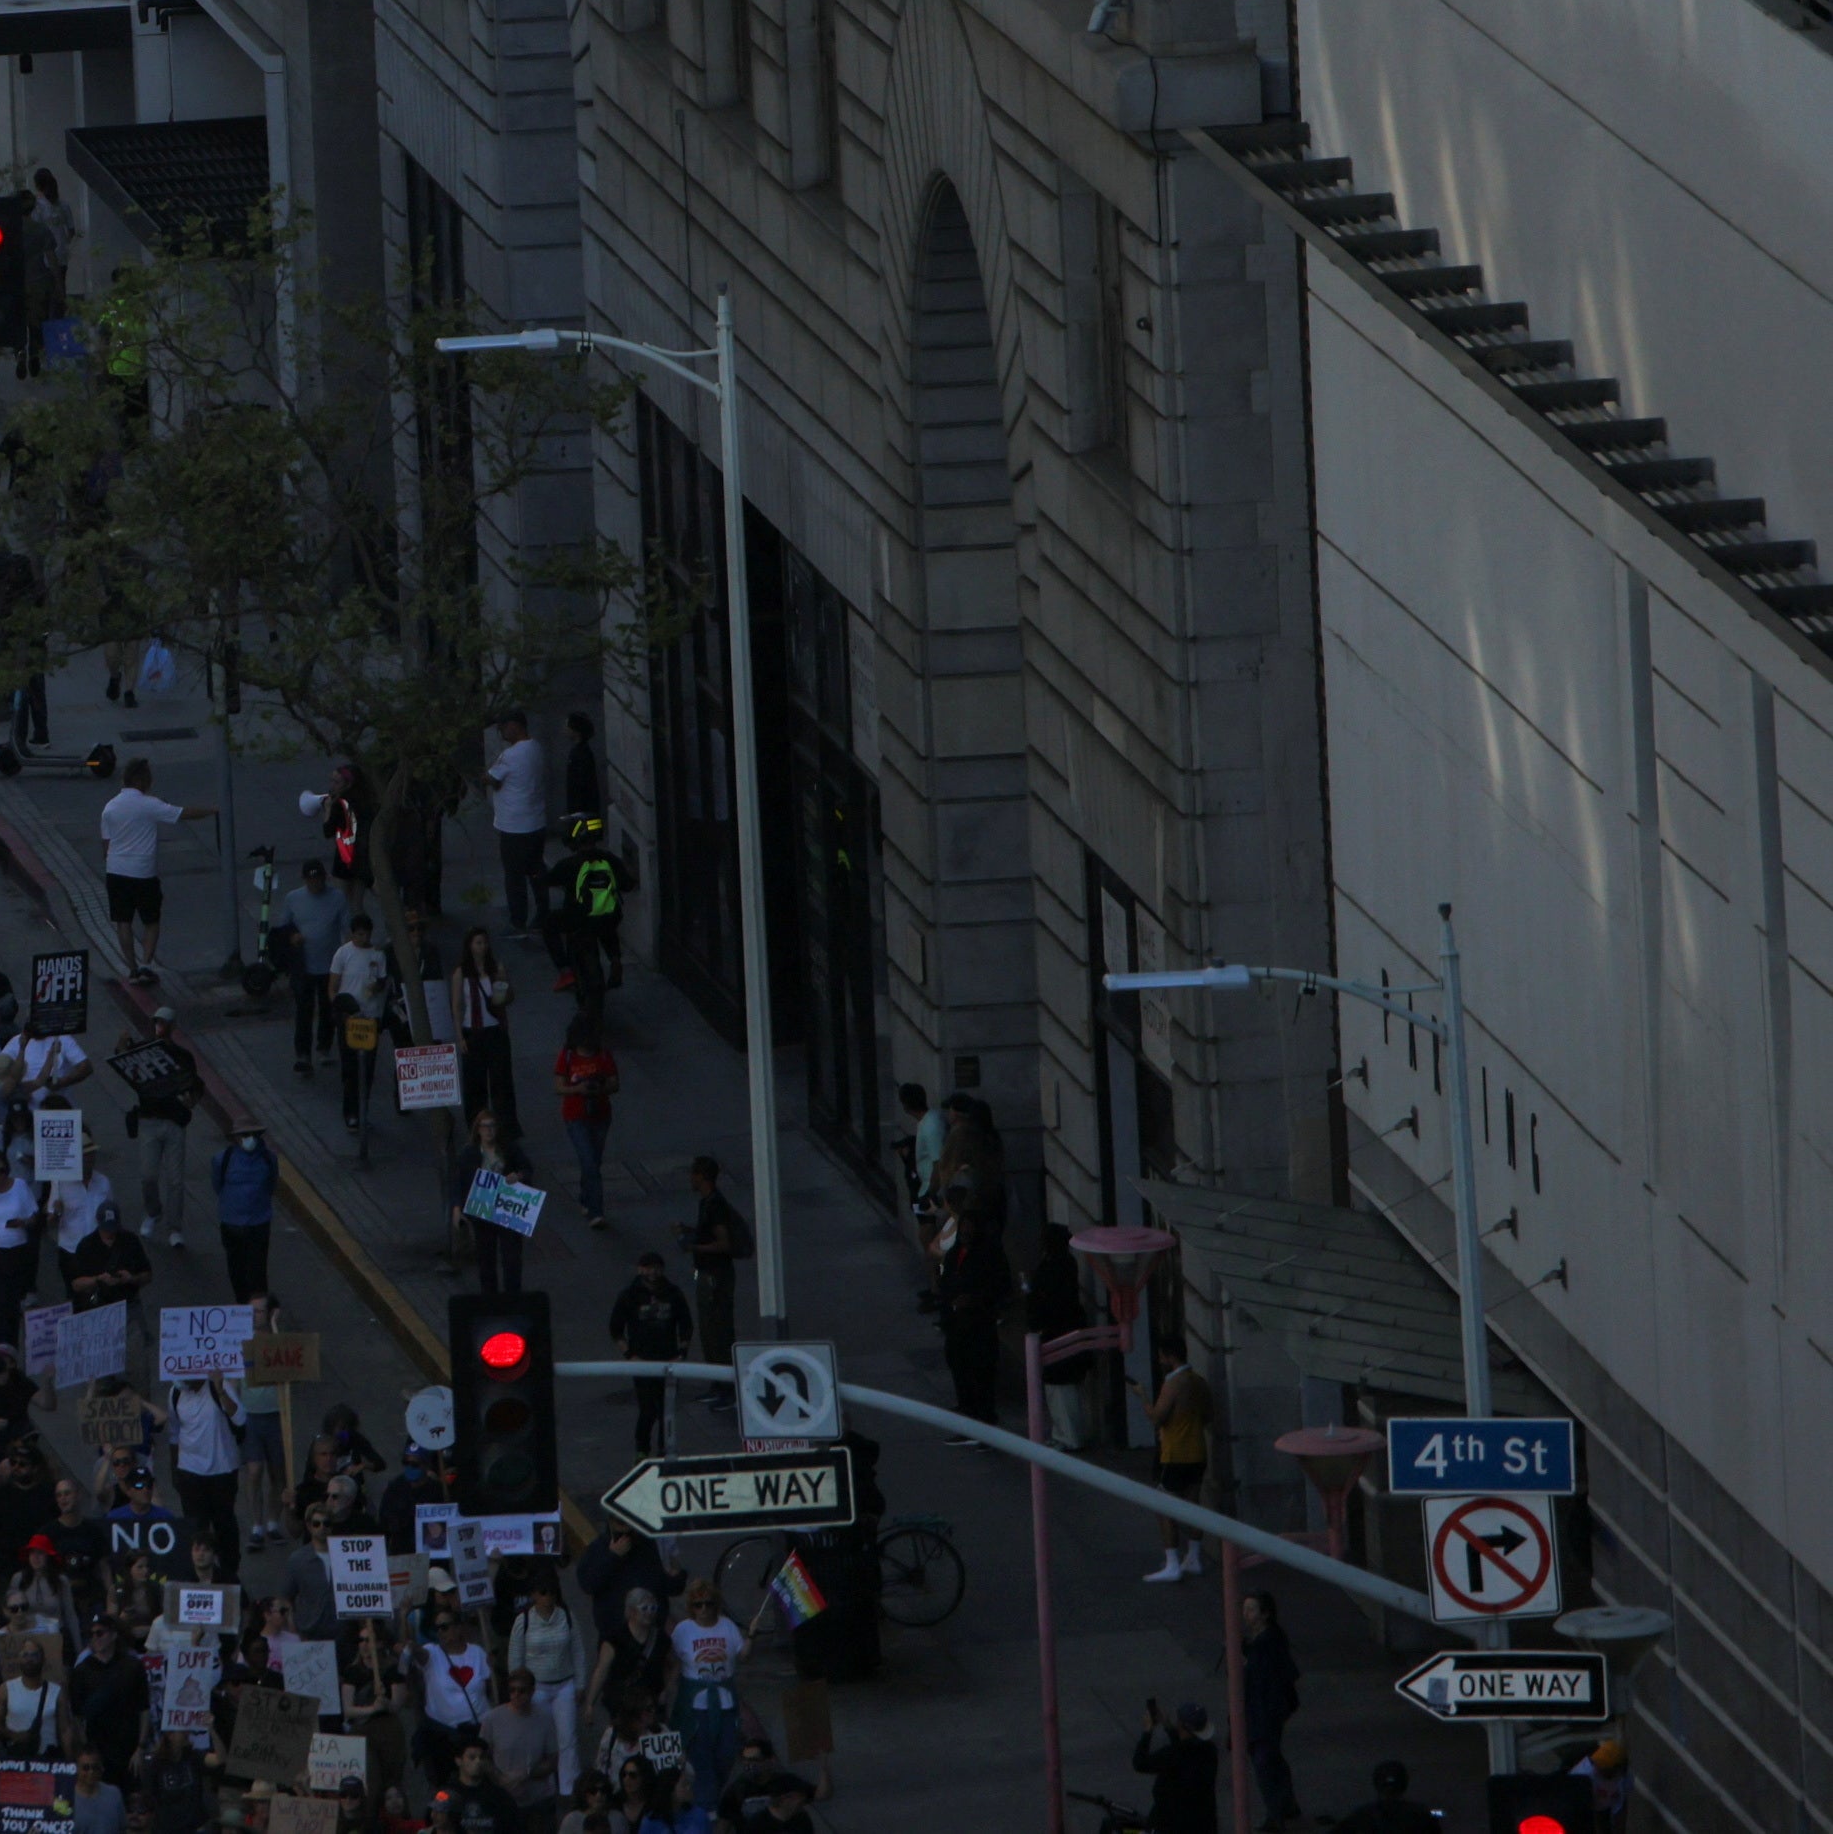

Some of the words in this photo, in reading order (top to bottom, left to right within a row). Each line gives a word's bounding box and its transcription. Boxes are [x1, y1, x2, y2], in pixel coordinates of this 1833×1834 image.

[36, 955, 82, 976] HANDS
[36, 972, 83, 1003] OFF!
[399, 1064, 417, 1080] NO
[418, 1061, 455, 1077] STOPPING
[421, 1078, 454, 1092] MIDNIGHT
[189, 1308, 226, 1336] NO
[193, 1337, 216, 1350] TO
[745, 1438, 764, 1453] NO
[1414, 1433, 1485, 1479] 4th
[1503, 1437, 1549, 1476] St
[661, 1479, 730, 1514] ONE
[755, 1471, 827, 1507] WAY
[111, 1521, 176, 1555] NO
[341, 1541, 372, 1552] STOP
[347, 1559, 371, 1571] THE
[346, 1595, 383, 1608] COUP!
[1459, 1674, 1514, 1697] ONE
[1525, 1674, 1581, 1697] WAY
[0, 1806, 44, 1820] THANK
